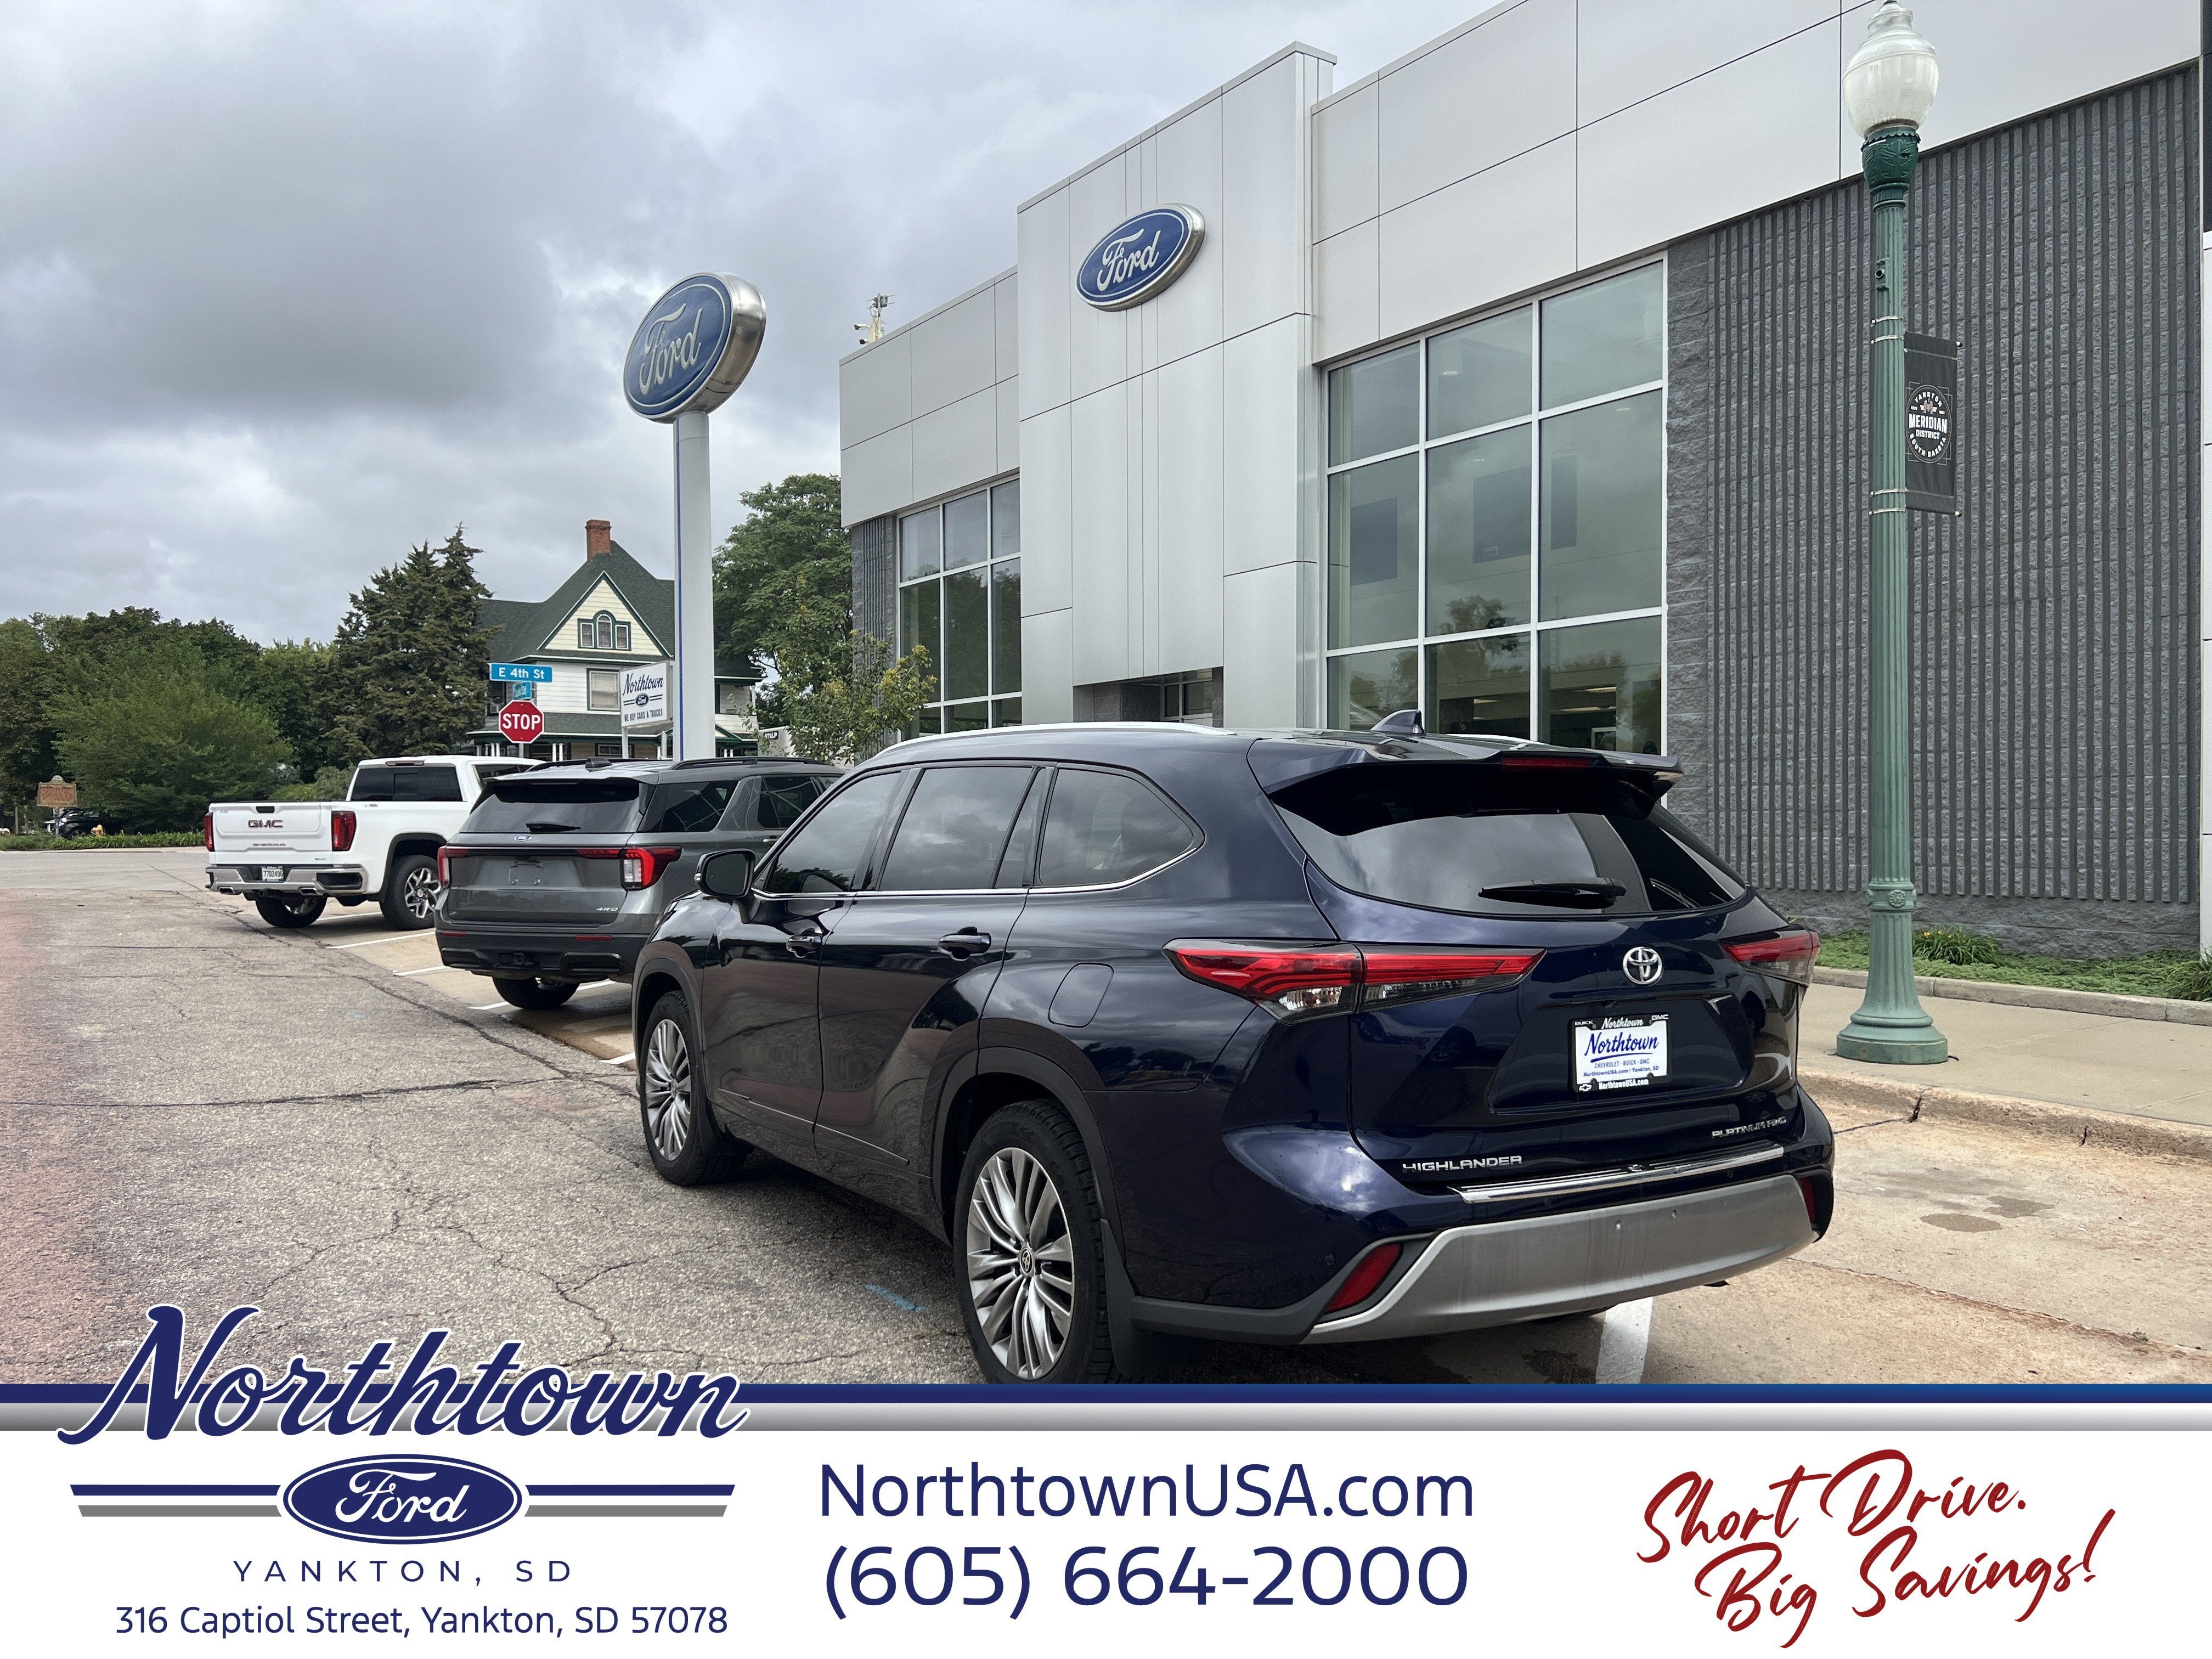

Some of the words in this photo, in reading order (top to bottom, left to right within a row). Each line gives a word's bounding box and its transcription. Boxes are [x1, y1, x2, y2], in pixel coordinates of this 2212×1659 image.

[1097, 228, 1161, 291] Ford
[639, 303, 703, 395] Ford
[1914, 391, 1943, 408] YANKTON
[1909, 413, 1947, 433] MERIDIAN
[1915, 429, 1940, 439] DISTRICT
[1910, 433, 1926, 456] SOUTH
[1927, 437, 1946, 458] DAKOTA
[499, 667, 506, 678] E
[510, 668, 529, 678] 4th
[533, 669, 545, 679] St
[622, 673, 664, 696] Northtown
[502, 713, 541, 730] STOP
[637, 711, 645, 720] CARS
[650, 708, 663, 718] TRUCKS
[249, 820, 284, 828] GMC
[1601, 1017, 1644, 1030] Northtown
[1584, 1031, 1659, 1056] Northtown
[1599, 1079, 1649, 1090] NorthtownUSA.com
[1402, 1155, 1522, 1173] HIGHLANDER
